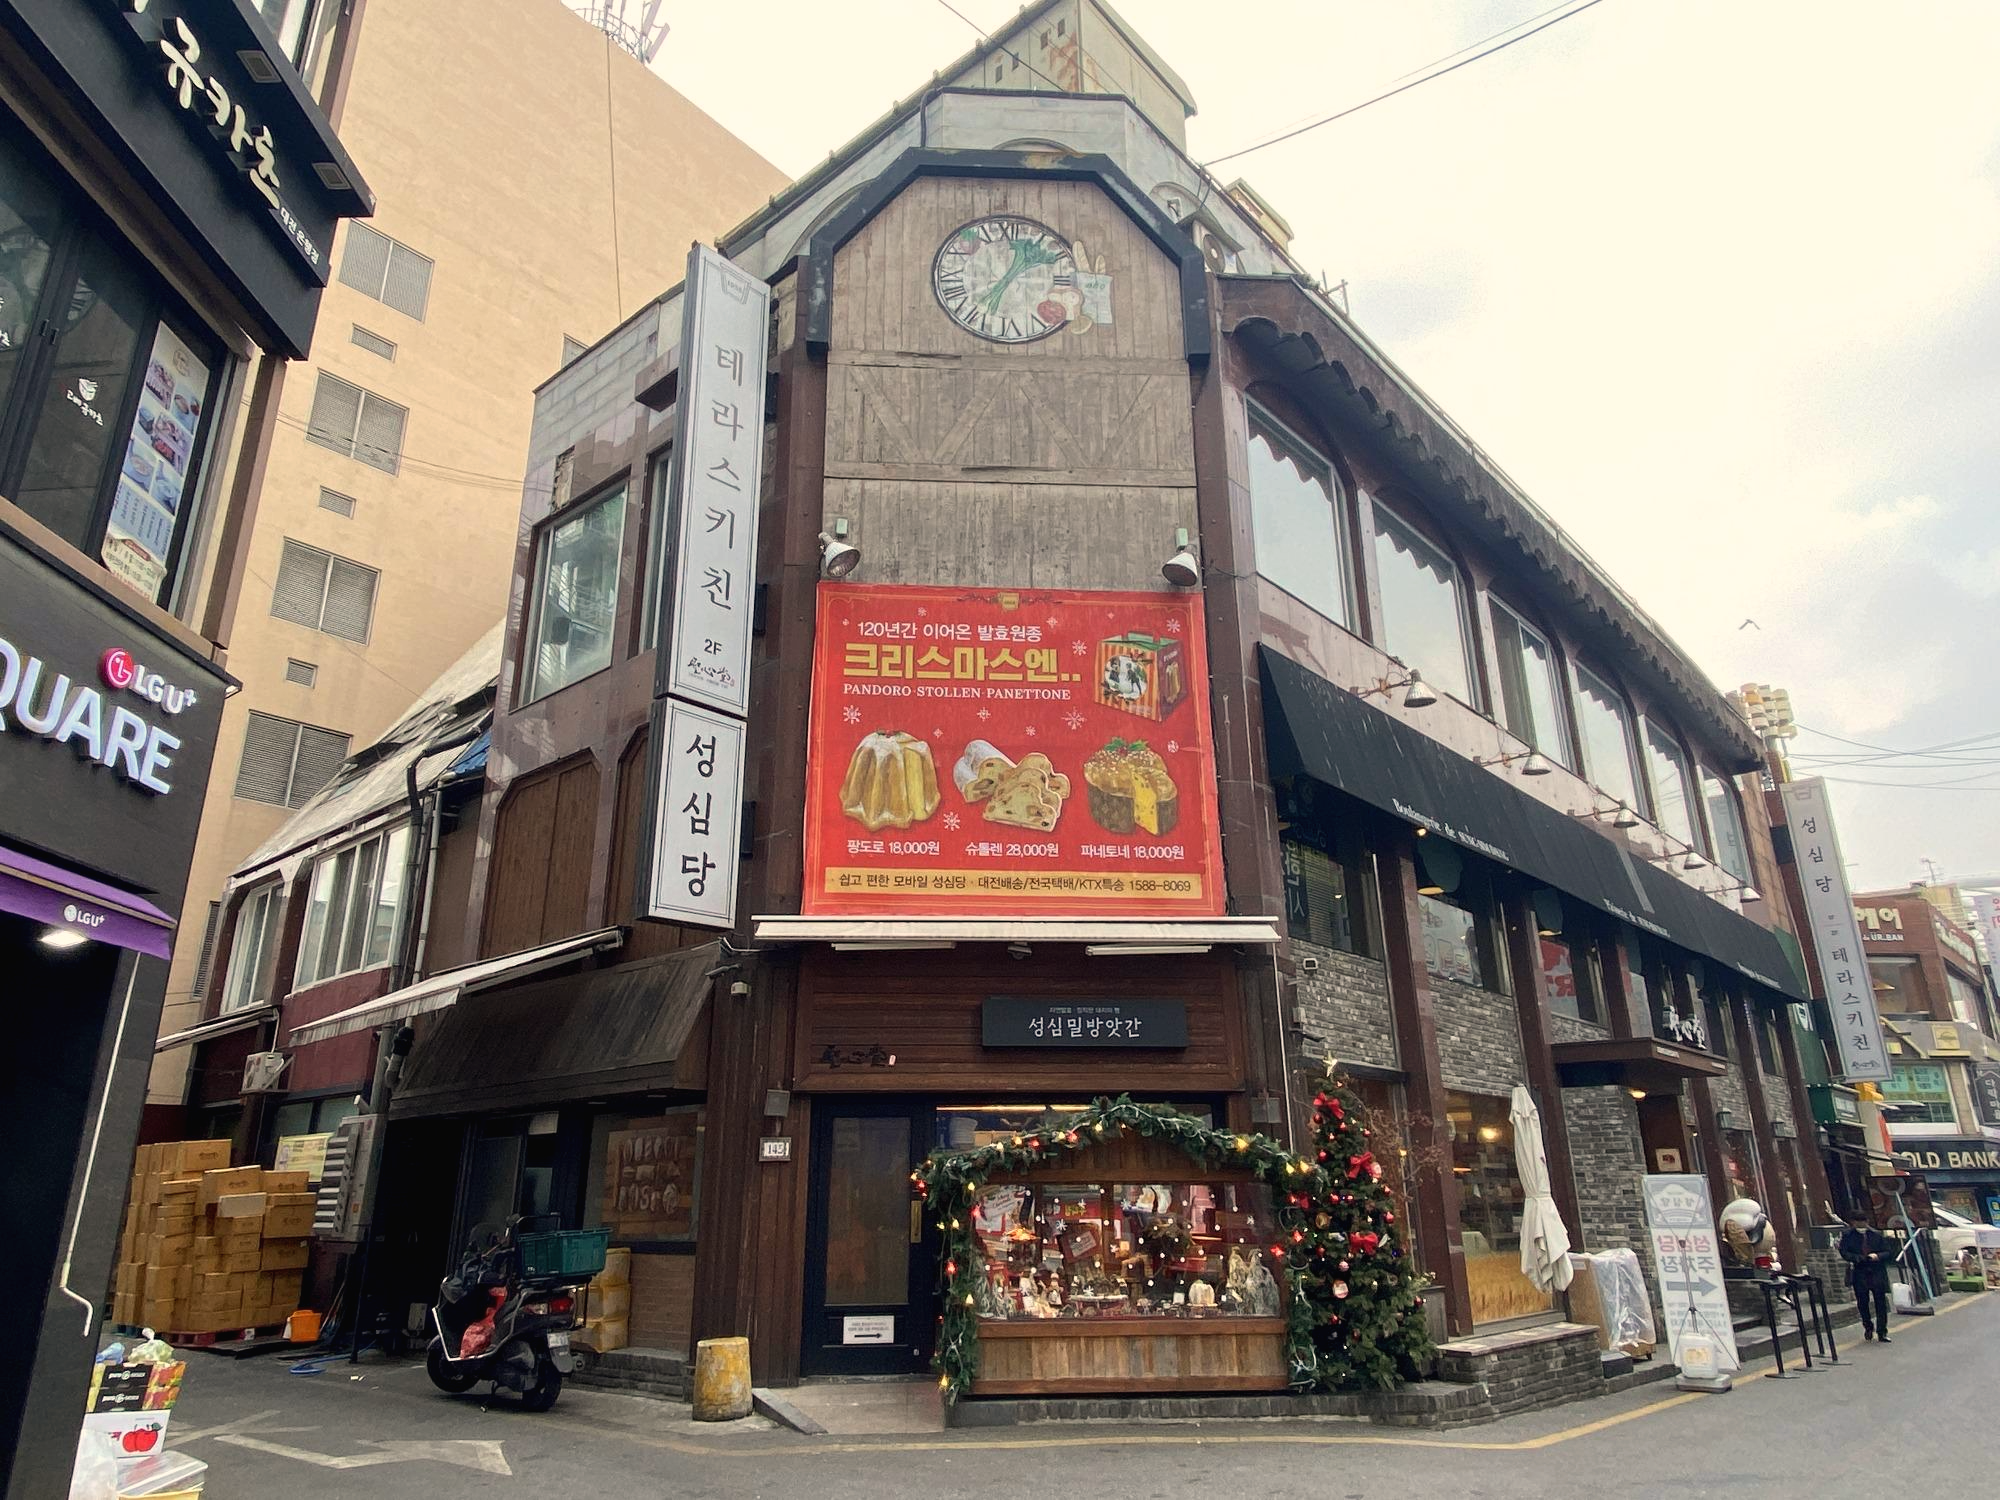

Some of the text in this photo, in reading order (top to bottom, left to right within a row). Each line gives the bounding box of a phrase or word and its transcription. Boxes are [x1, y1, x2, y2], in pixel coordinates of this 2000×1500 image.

[700, 343, 744, 612] 테라스키친
[857, 621, 1043, 643] 120년간 이어온 발효원종
[704, 638, 722, 655] 2F
[842, 683, 1071, 700] PANDORO STOLLEN PANETTONE
[680, 734, 717, 897] 성심당
[846, 839, 940, 857] 팡도로 18,000원
[964, 841, 1060, 859] 슈톨렌 28,000원
[1080, 844, 1185, 860] 파네토네 18,000원
[1801, 816, 1833, 894] 성심당
[838, 873, 1192, 893] 쉽고 편한 모바일 성심당 대전배송/전국택배/KTX특송 1588-8069
[1832, 947, 1871, 1051] 테라스키친
[1028, 1016, 1143, 1039] 성심밀방앗간
[1947, 1151, 2000, 1169] BANK
